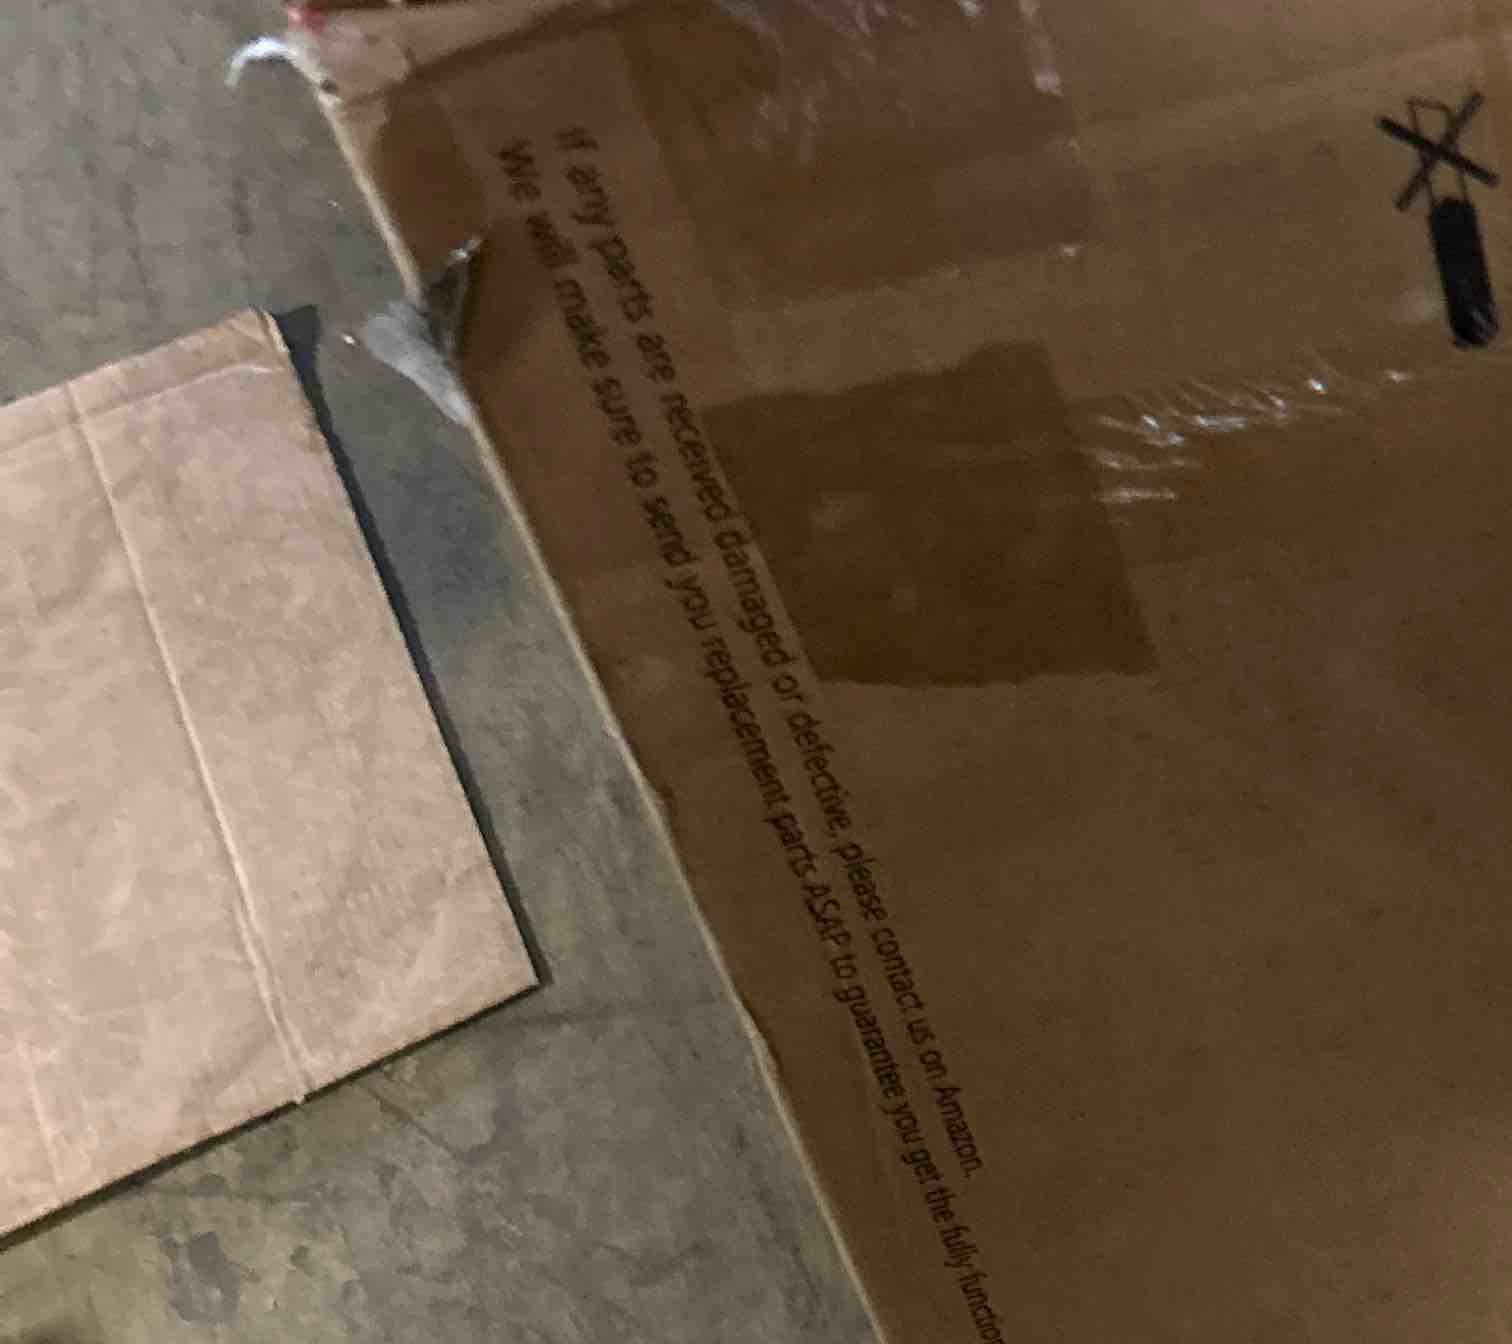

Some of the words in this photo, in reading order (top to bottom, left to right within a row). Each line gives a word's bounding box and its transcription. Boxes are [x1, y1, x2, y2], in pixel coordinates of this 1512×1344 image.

[492, 139, 542, 203] We
[562, 164, 618, 228] any
[525, 209, 579, 269] will
[586, 232, 654, 324] parts
[553, 277, 611, 370] make
[635, 330, 676, 384] are
[591, 375, 643, 447] sure
[624, 452, 660, 488] to
[659, 392, 734, 523] received
[641, 495, 701, 567] send
[663, 573, 719, 632] you
[713, 529, 800, 668] damaged
[772, 672, 805, 702] or
[700, 635, 791, 808] replacement
[761, 811, 818, 879] parts
[830, 841, 888, 922] please
[801, 884, 852, 946] ASAP
[830, 953, 858, 979] to
[870, 927, 925, 1010] contact
[831, 984, 906, 1099] guarantee
[906, 1018, 936, 1045] us
[919, 1050, 948, 1081] on
[880, 1101, 925, 1145] you
[900, 1147, 944, 1184] get
[923, 1186, 957, 1232] the
[939, 1222, 980, 1269] fully
